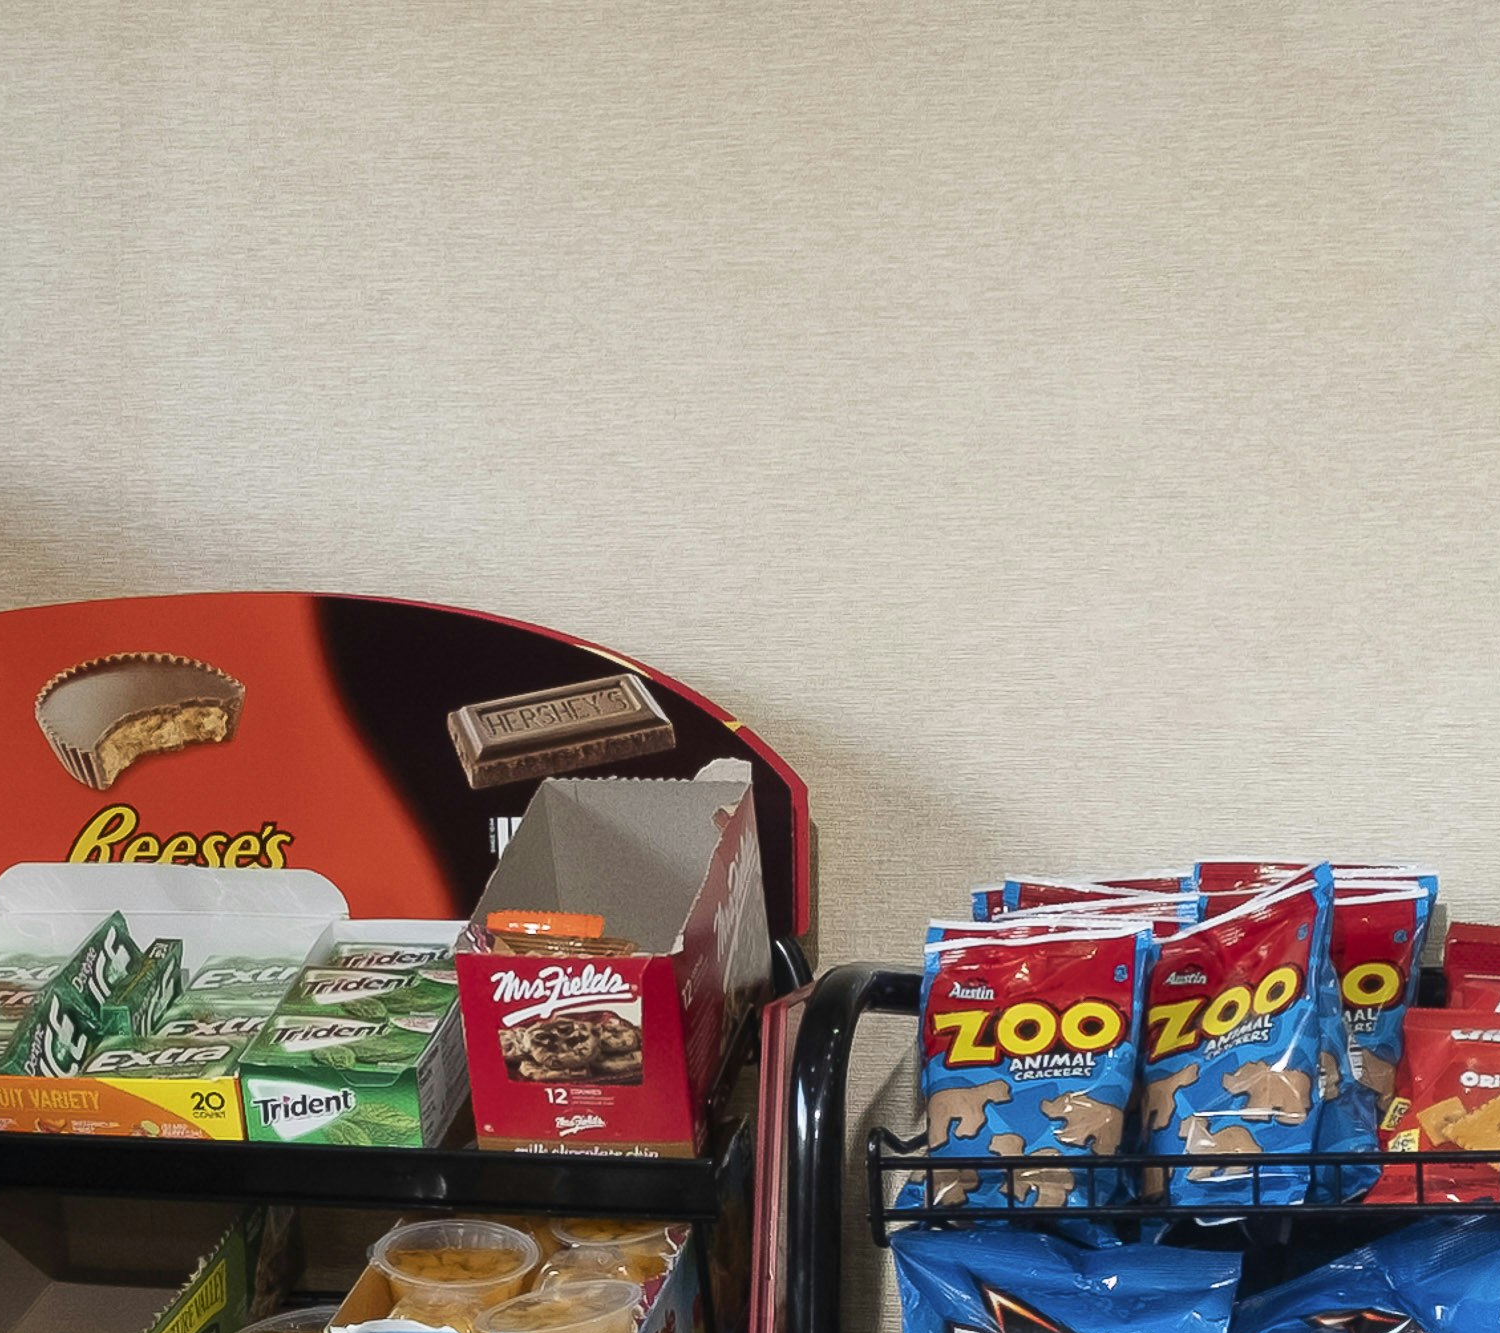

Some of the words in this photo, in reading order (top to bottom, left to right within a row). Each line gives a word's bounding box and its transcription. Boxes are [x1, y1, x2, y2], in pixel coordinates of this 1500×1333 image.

[481, 684, 634, 738] HERSHEY'S
[65, 801, 293, 871] Reese's
[341, 949, 450, 969] Trident
[304, 975, 419, 996] Trident
[545, 964, 630, 1002] Fields
[1165, 971, 1207, 986] Austin
[948, 983, 995, 1000] Austin
[1148, 966, 1300, 1061] ZOO
[272, 1021, 391, 1044] Trident
[933, 1001, 1127, 1063] ZOO
[1204, 1015, 1273, 1054] ANIMAL
[83, 1044, 231, 1074] Extra
[1008, 1053, 1096, 1071] ANIMAL
[1014, 1067, 1092, 1081] CRACKERS
[28, 1089, 99, 1110] VARIETY
[191, 1092, 225, 1111] 20
[253, 1089, 356, 1125] Trident
[545, 1088, 568, 1104] 12
